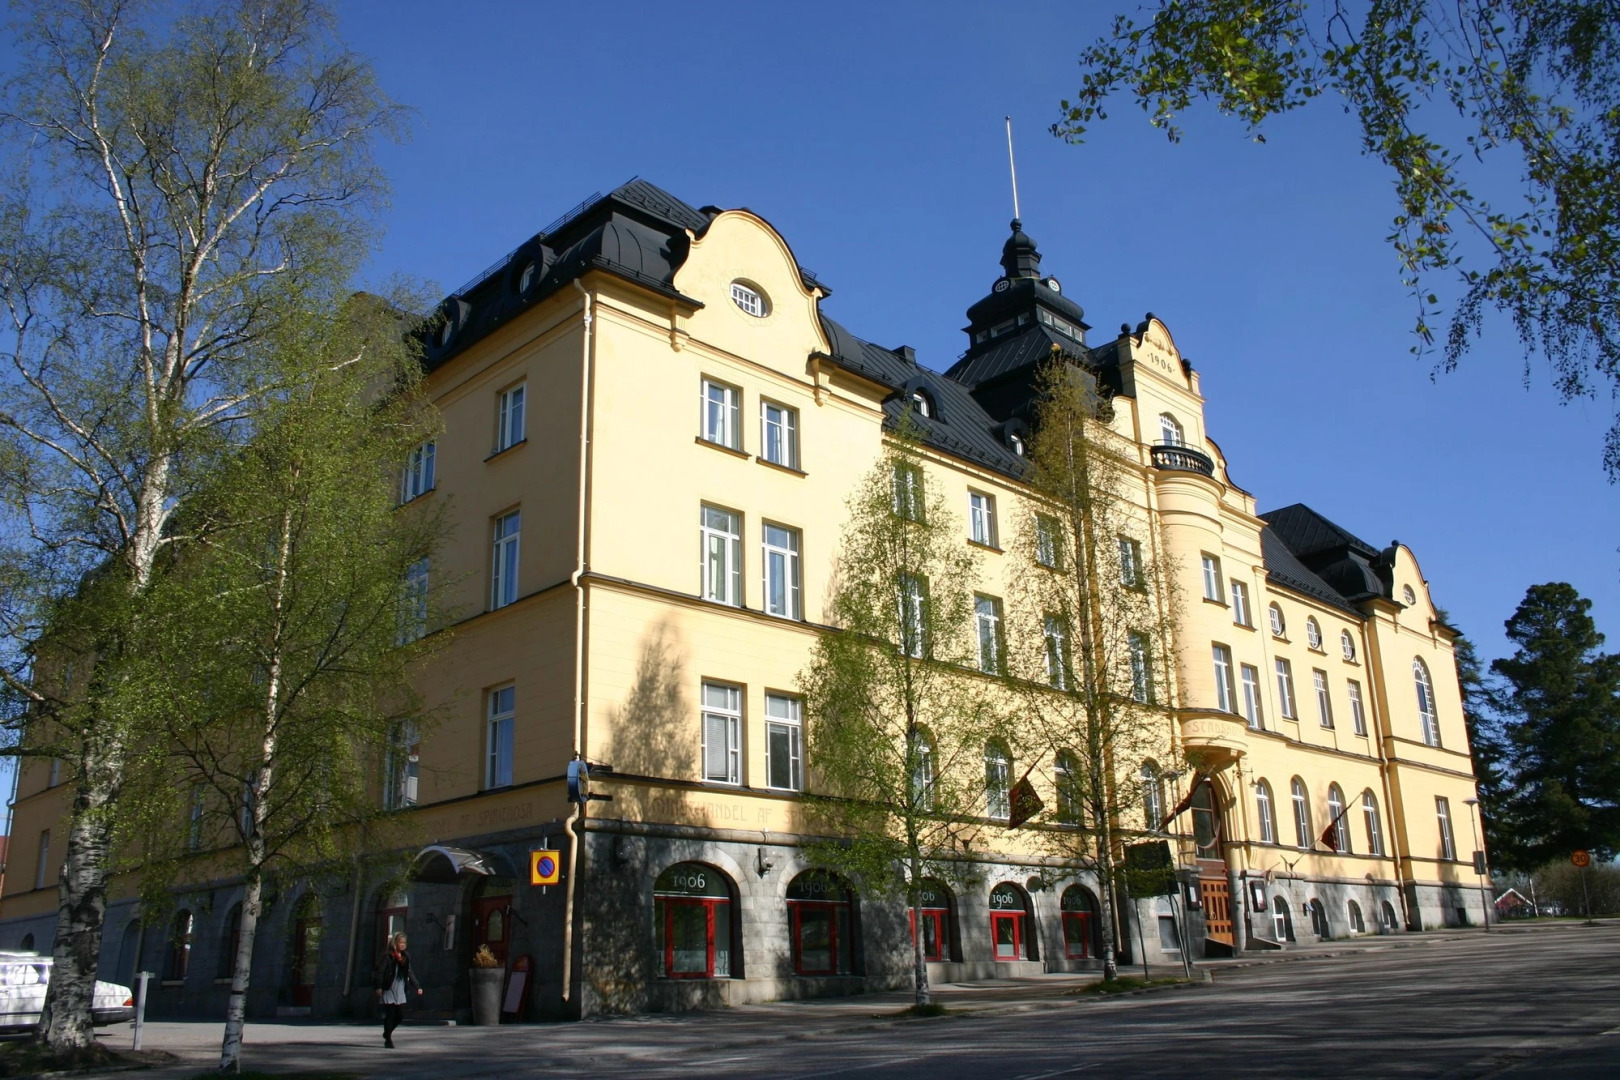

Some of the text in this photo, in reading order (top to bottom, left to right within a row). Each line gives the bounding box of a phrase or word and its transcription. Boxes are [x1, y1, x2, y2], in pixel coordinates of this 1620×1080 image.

[1574, 854, 1587, 863] 30
[674, 872, 706, 891] 1906
[800, 881, 828, 899] 1906
[922, 890, 936, 902] 06
[992, 891, 1014, 909] 1906
[1063, 894, 1082, 909] 1906
